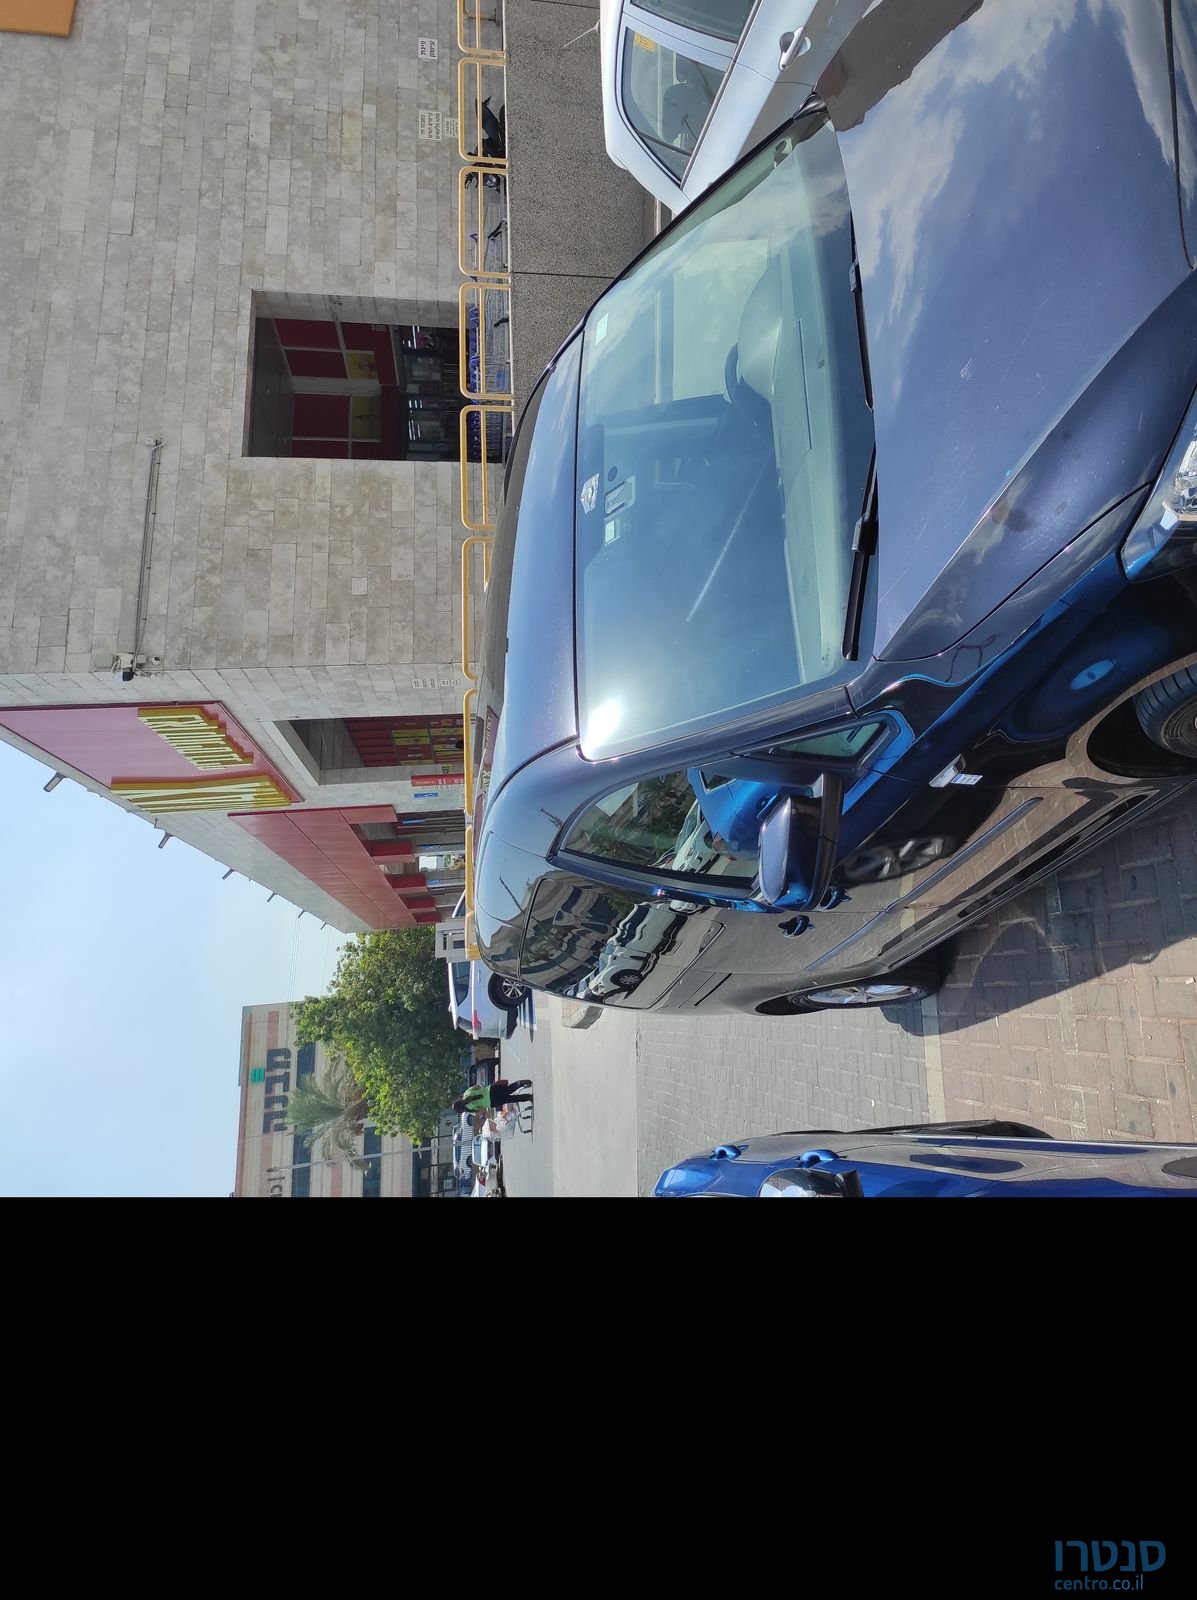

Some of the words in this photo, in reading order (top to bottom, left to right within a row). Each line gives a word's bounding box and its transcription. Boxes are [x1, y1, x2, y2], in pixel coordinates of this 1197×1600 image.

[136, 714, 218, 731] כאן
[156, 731, 226, 754] קונים
[110, 779, 291, 815] MAX
[262, 1047, 291, 1134] מבנה
